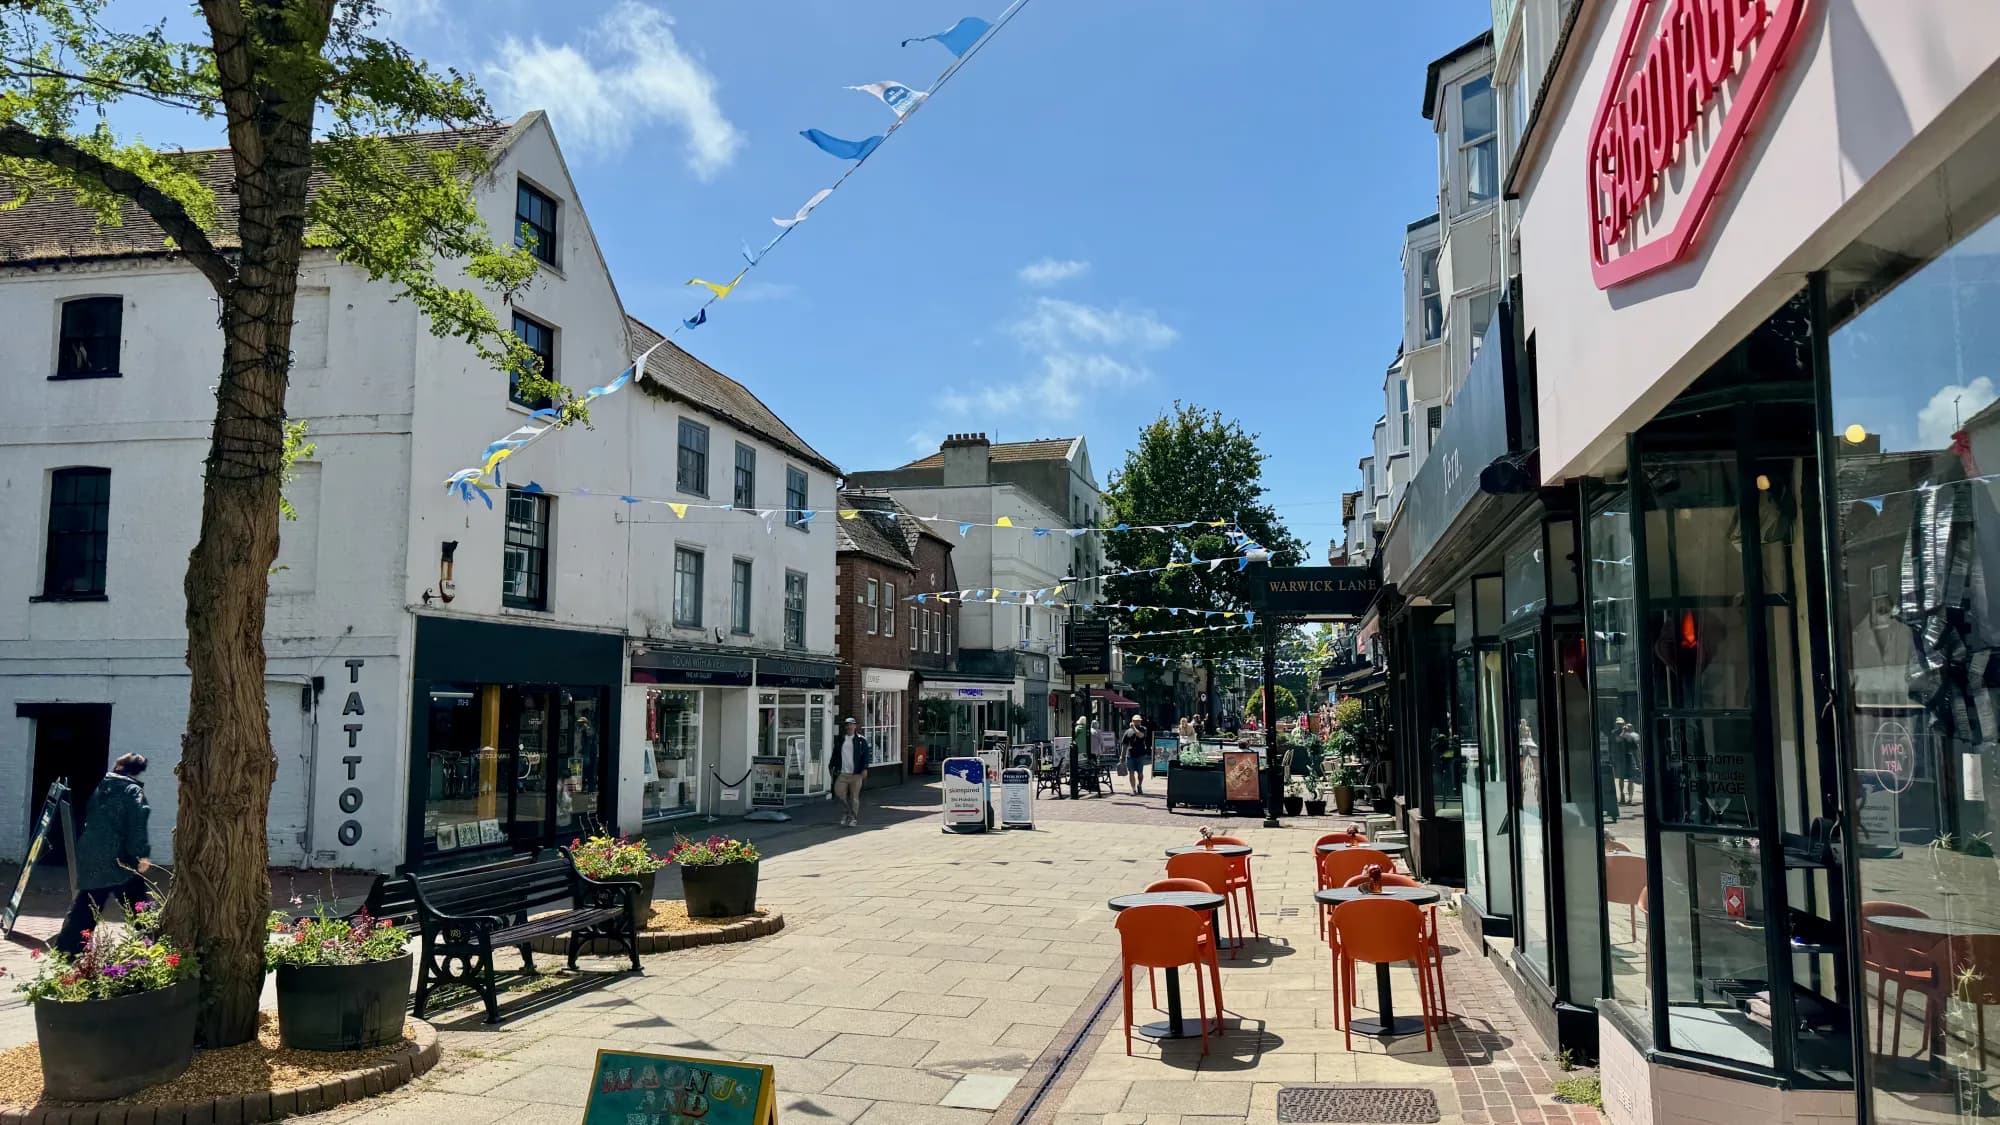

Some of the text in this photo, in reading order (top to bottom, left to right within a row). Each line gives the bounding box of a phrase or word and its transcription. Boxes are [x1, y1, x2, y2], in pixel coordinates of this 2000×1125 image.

[1269, 579, 1377, 592] WARWICK LANE
[337, 659, 365, 847] TATTOO
